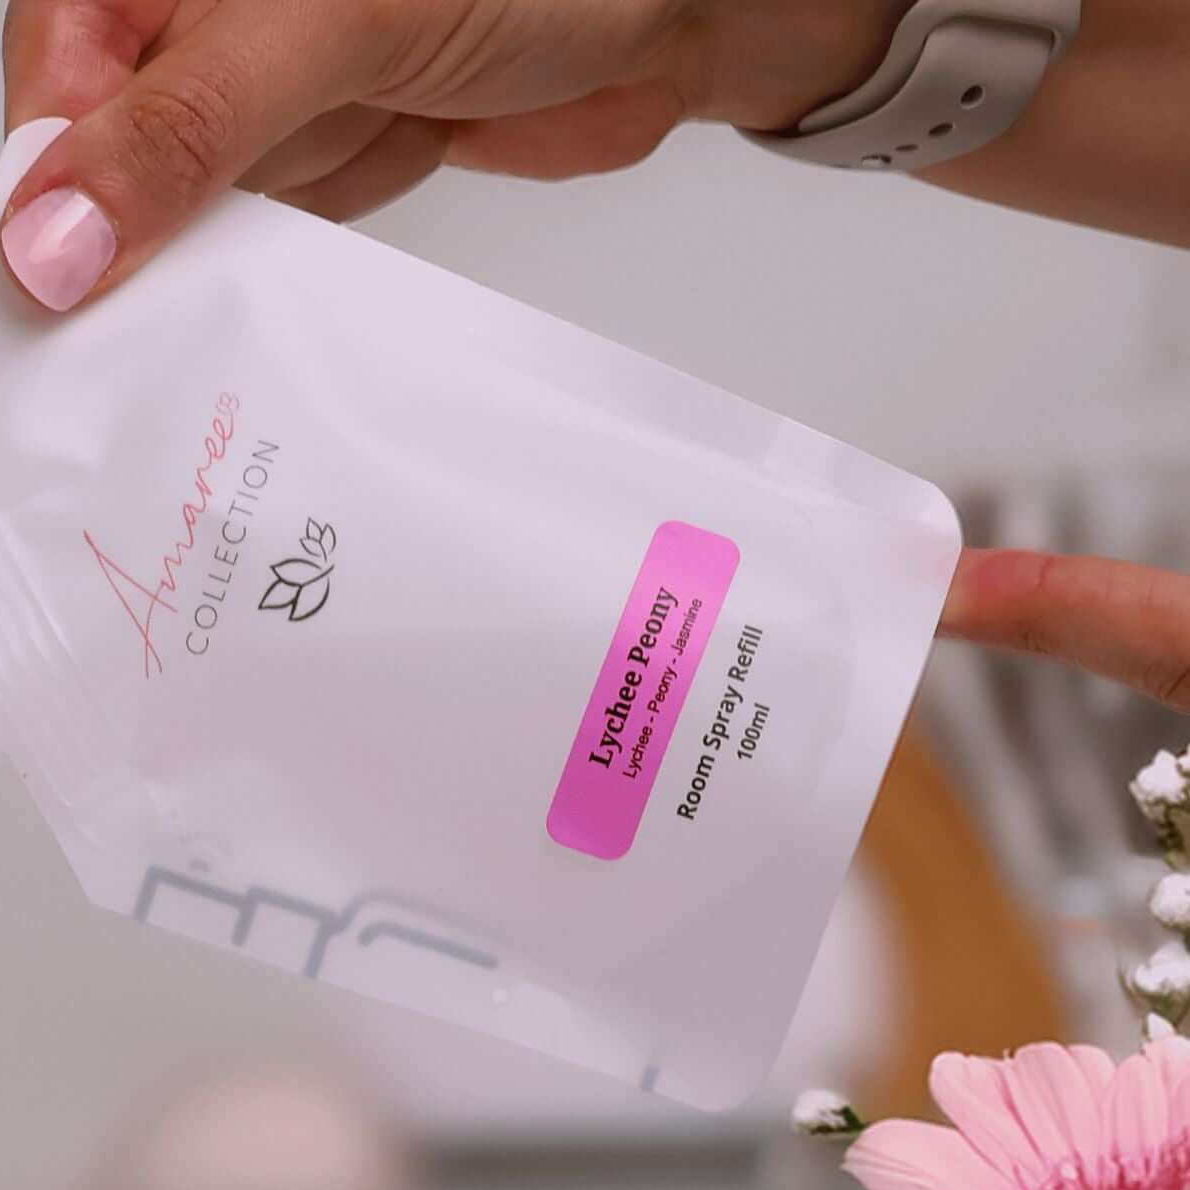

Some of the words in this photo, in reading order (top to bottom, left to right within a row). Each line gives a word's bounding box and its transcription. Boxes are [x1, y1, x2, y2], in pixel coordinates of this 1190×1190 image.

[82, 409, 235, 680] Amaree
[185, 438, 281, 656] COLLECTION
[588, 669, 643, 769] Lychee
[627, 586, 679, 668] Peony
[622, 726, 653, 780] Lychee
[647, 662, 678, 714] Peony
[670, 597, 703, 656] Jasmine
[676, 754, 715, 821] Room
[703, 684, 744, 751] Spray
[728, 624, 763, 683] Refill
[737, 702, 771, 761] 100ml
